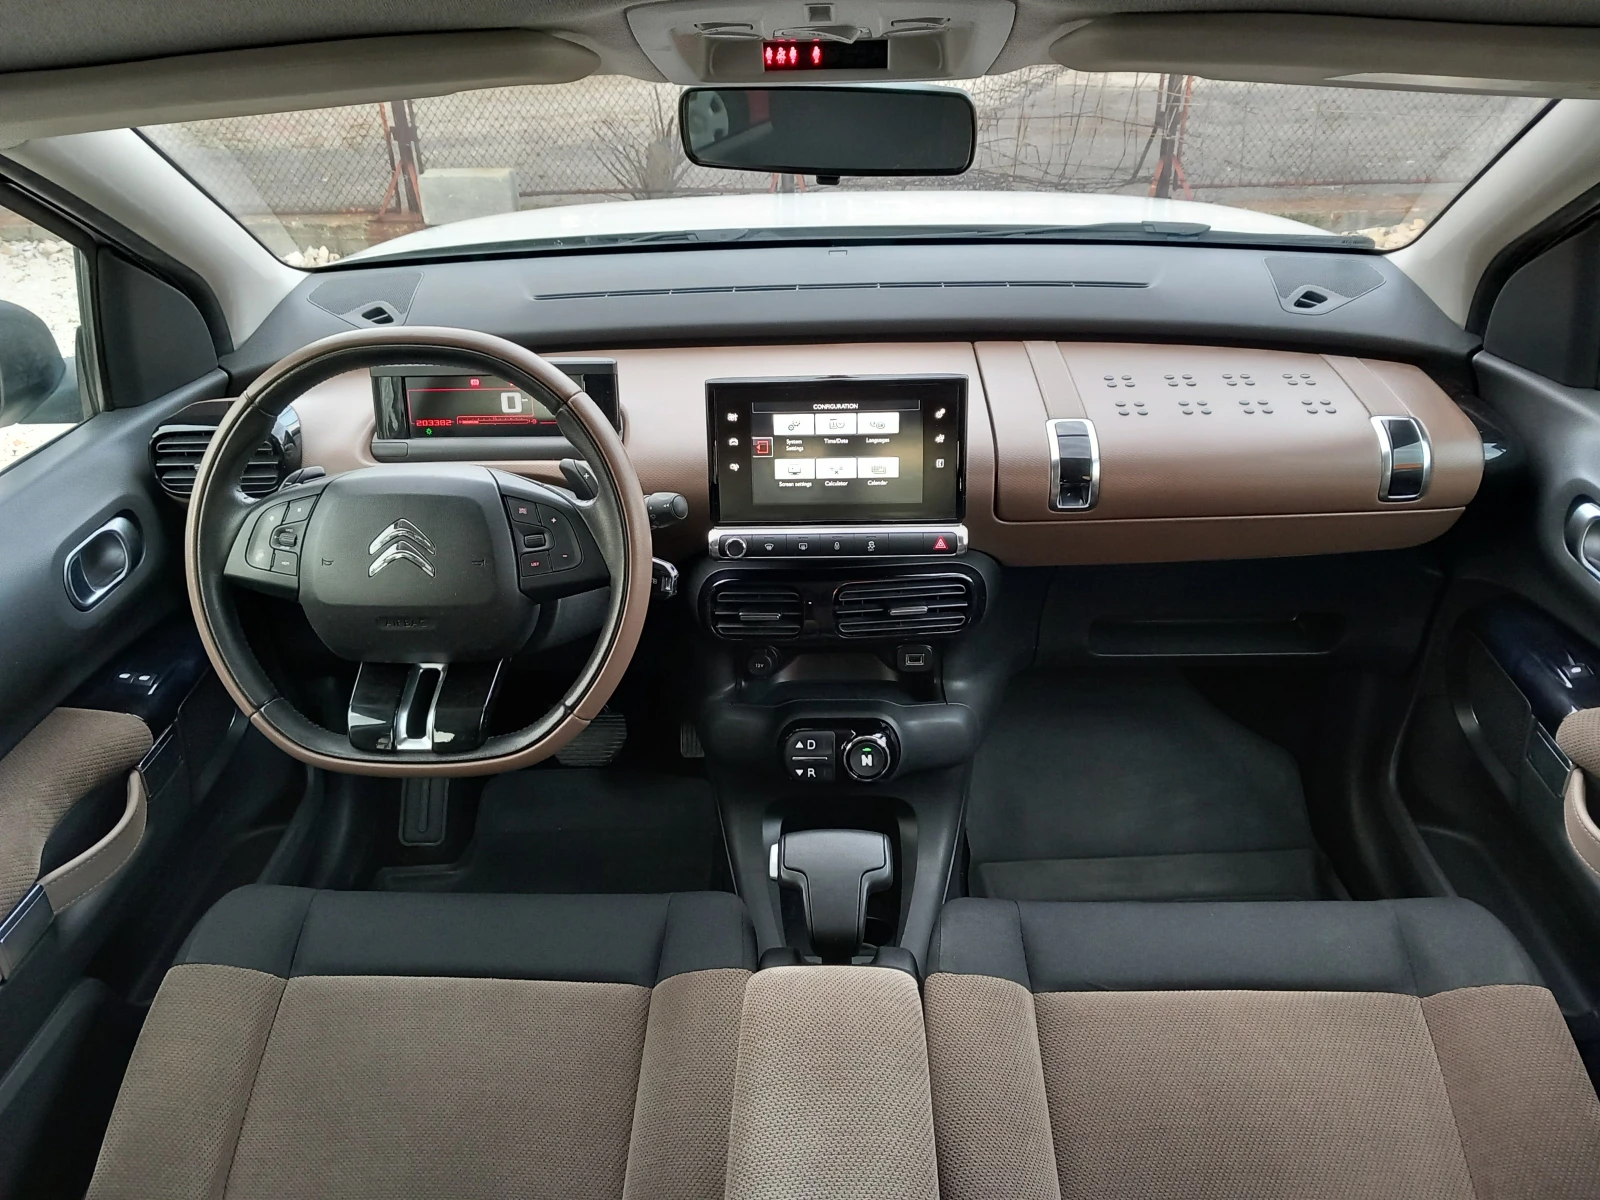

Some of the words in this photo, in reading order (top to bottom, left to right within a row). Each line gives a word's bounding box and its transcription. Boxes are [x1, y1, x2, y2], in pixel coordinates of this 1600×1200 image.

[500, 392, 523, 413] 0
[416, 419, 452, 427] 203382
[806, 739, 816, 750] D
[861, 754, 873, 767] N
[806, 768, 816, 778] R
